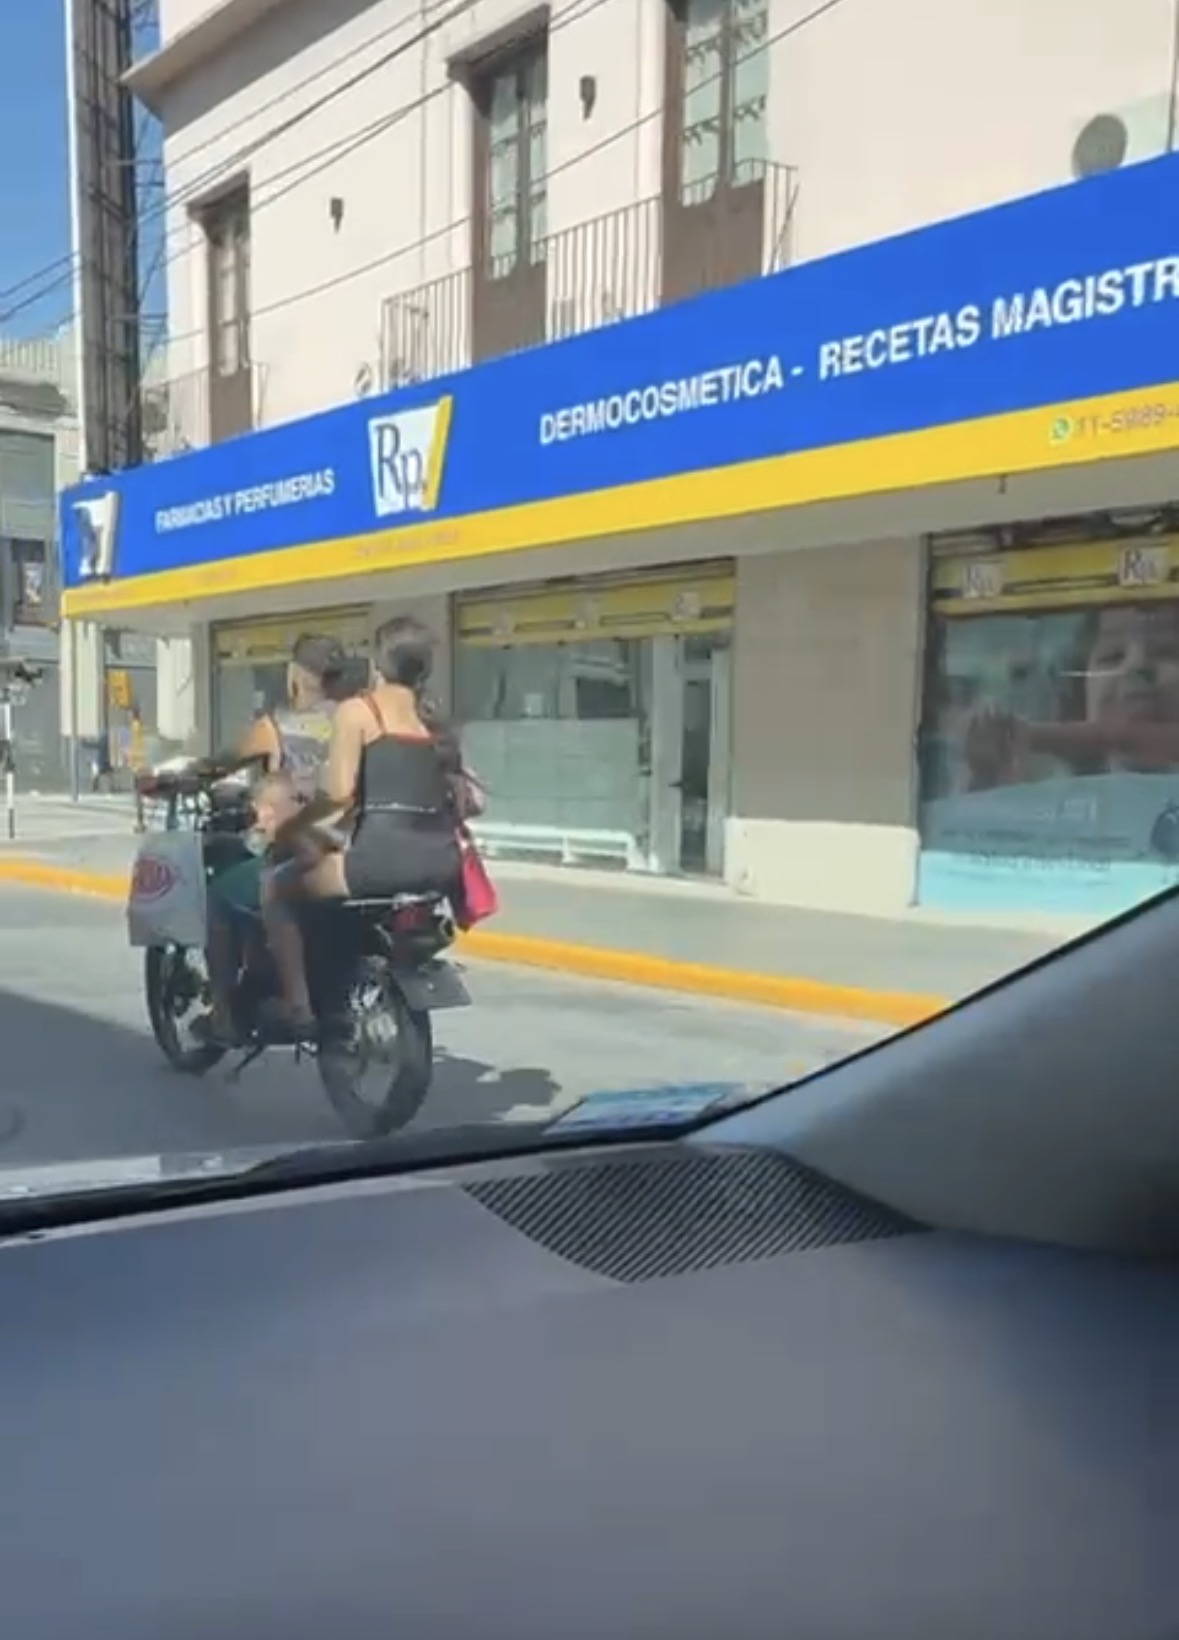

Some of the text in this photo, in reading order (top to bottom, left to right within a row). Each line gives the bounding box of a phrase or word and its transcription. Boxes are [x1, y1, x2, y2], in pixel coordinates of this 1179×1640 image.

[539, 354, 785, 446] DERMOCOSMETICA
[818, 304, 981, 381] RECETAS
[991, 253, 1179, 341] MAGISTR
[155, 496, 223, 534] FARMACIAS
[235, 467, 336, 516] PERFUMERIAS
